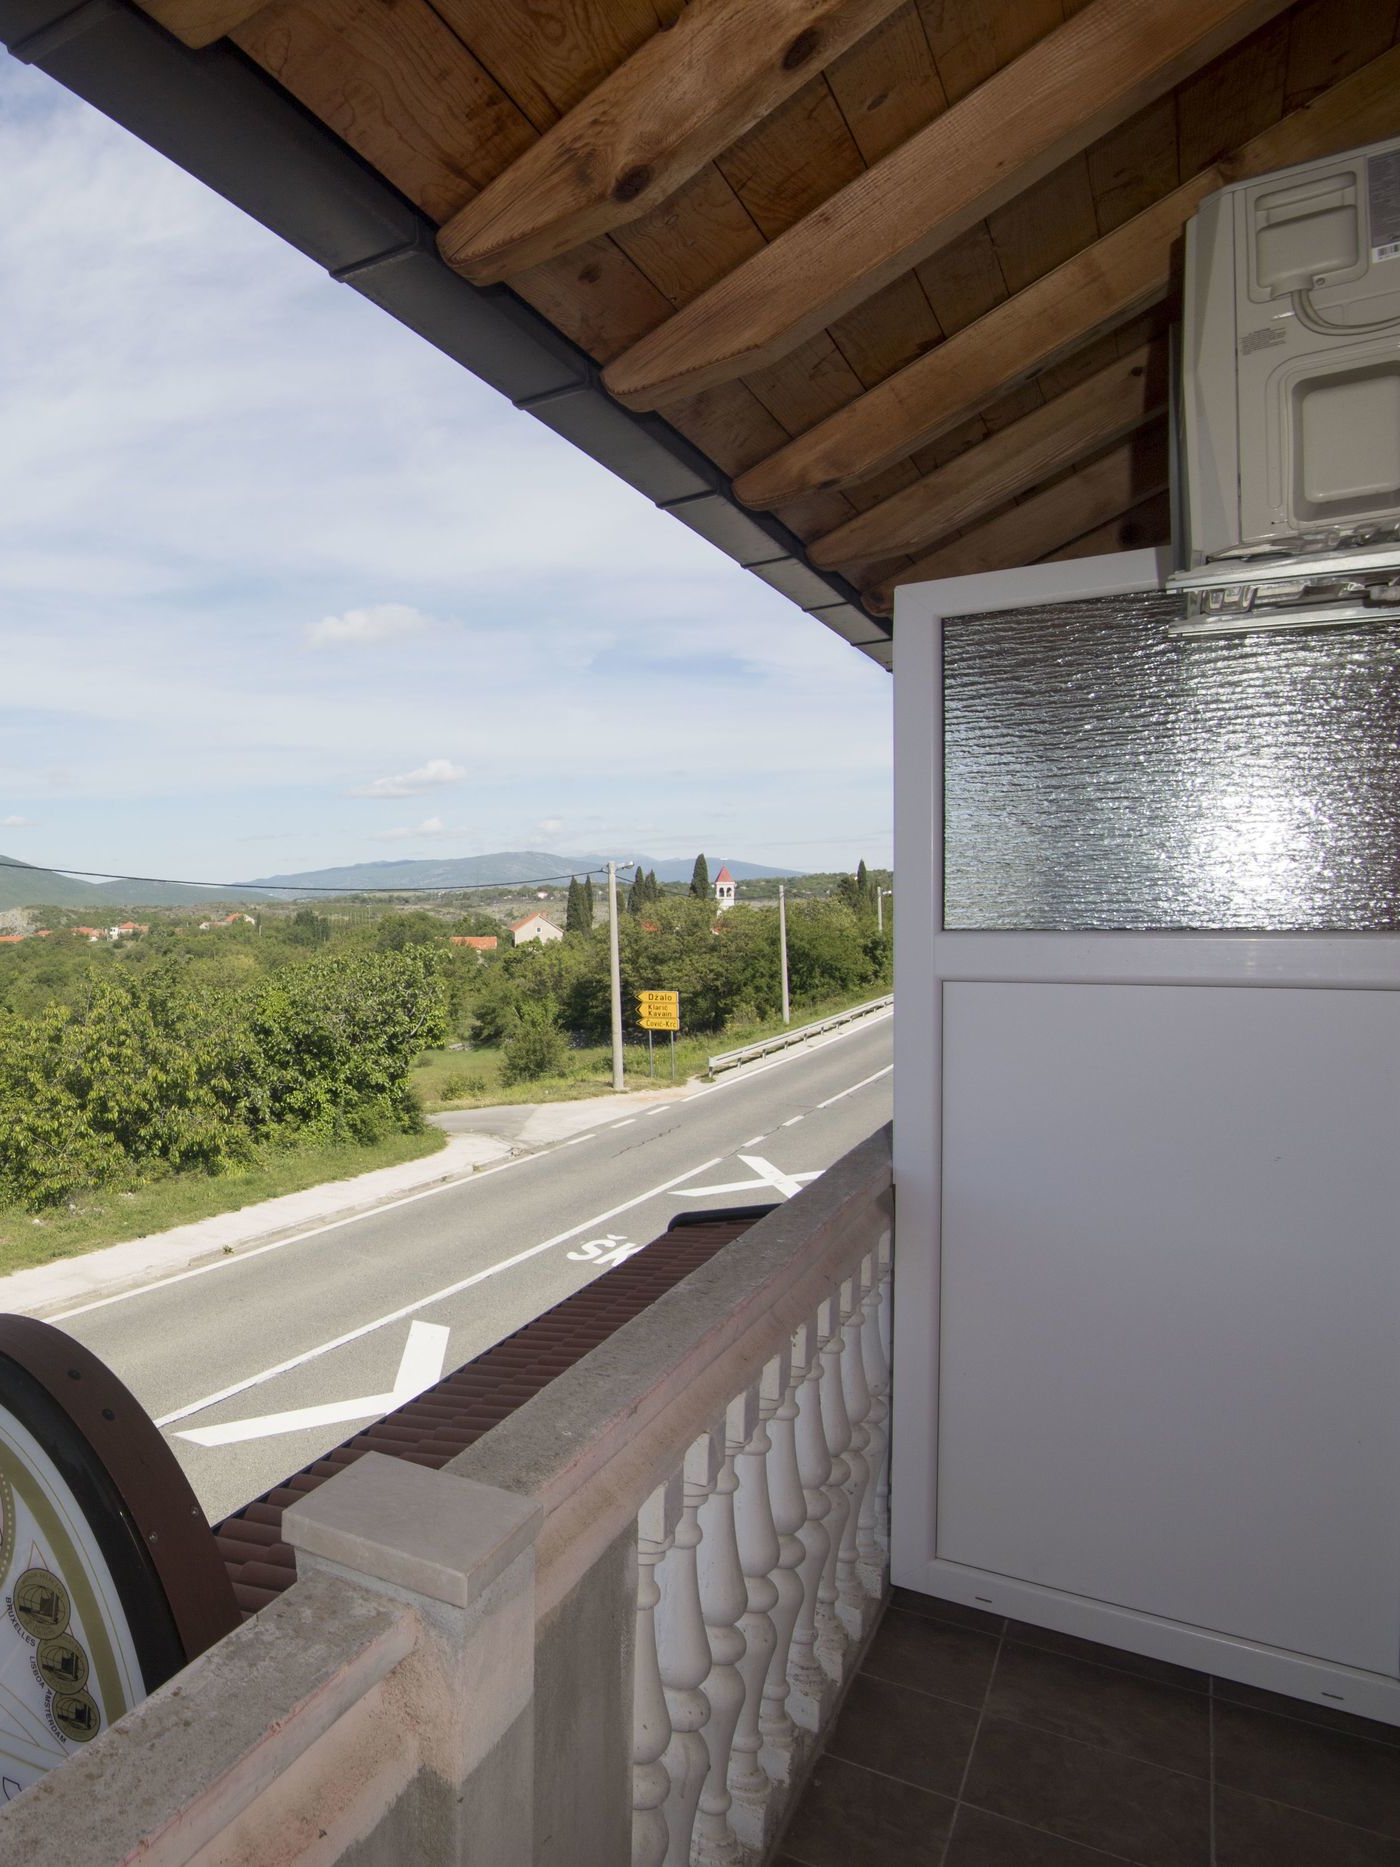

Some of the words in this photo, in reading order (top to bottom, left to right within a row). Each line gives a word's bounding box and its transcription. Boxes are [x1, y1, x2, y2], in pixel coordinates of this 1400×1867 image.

[5, 1596, 36, 1647] BRUXELLES
[29, 1655, 45, 1689] LISBOA
[43, 1687, 68, 1745] AMSTERDAM
